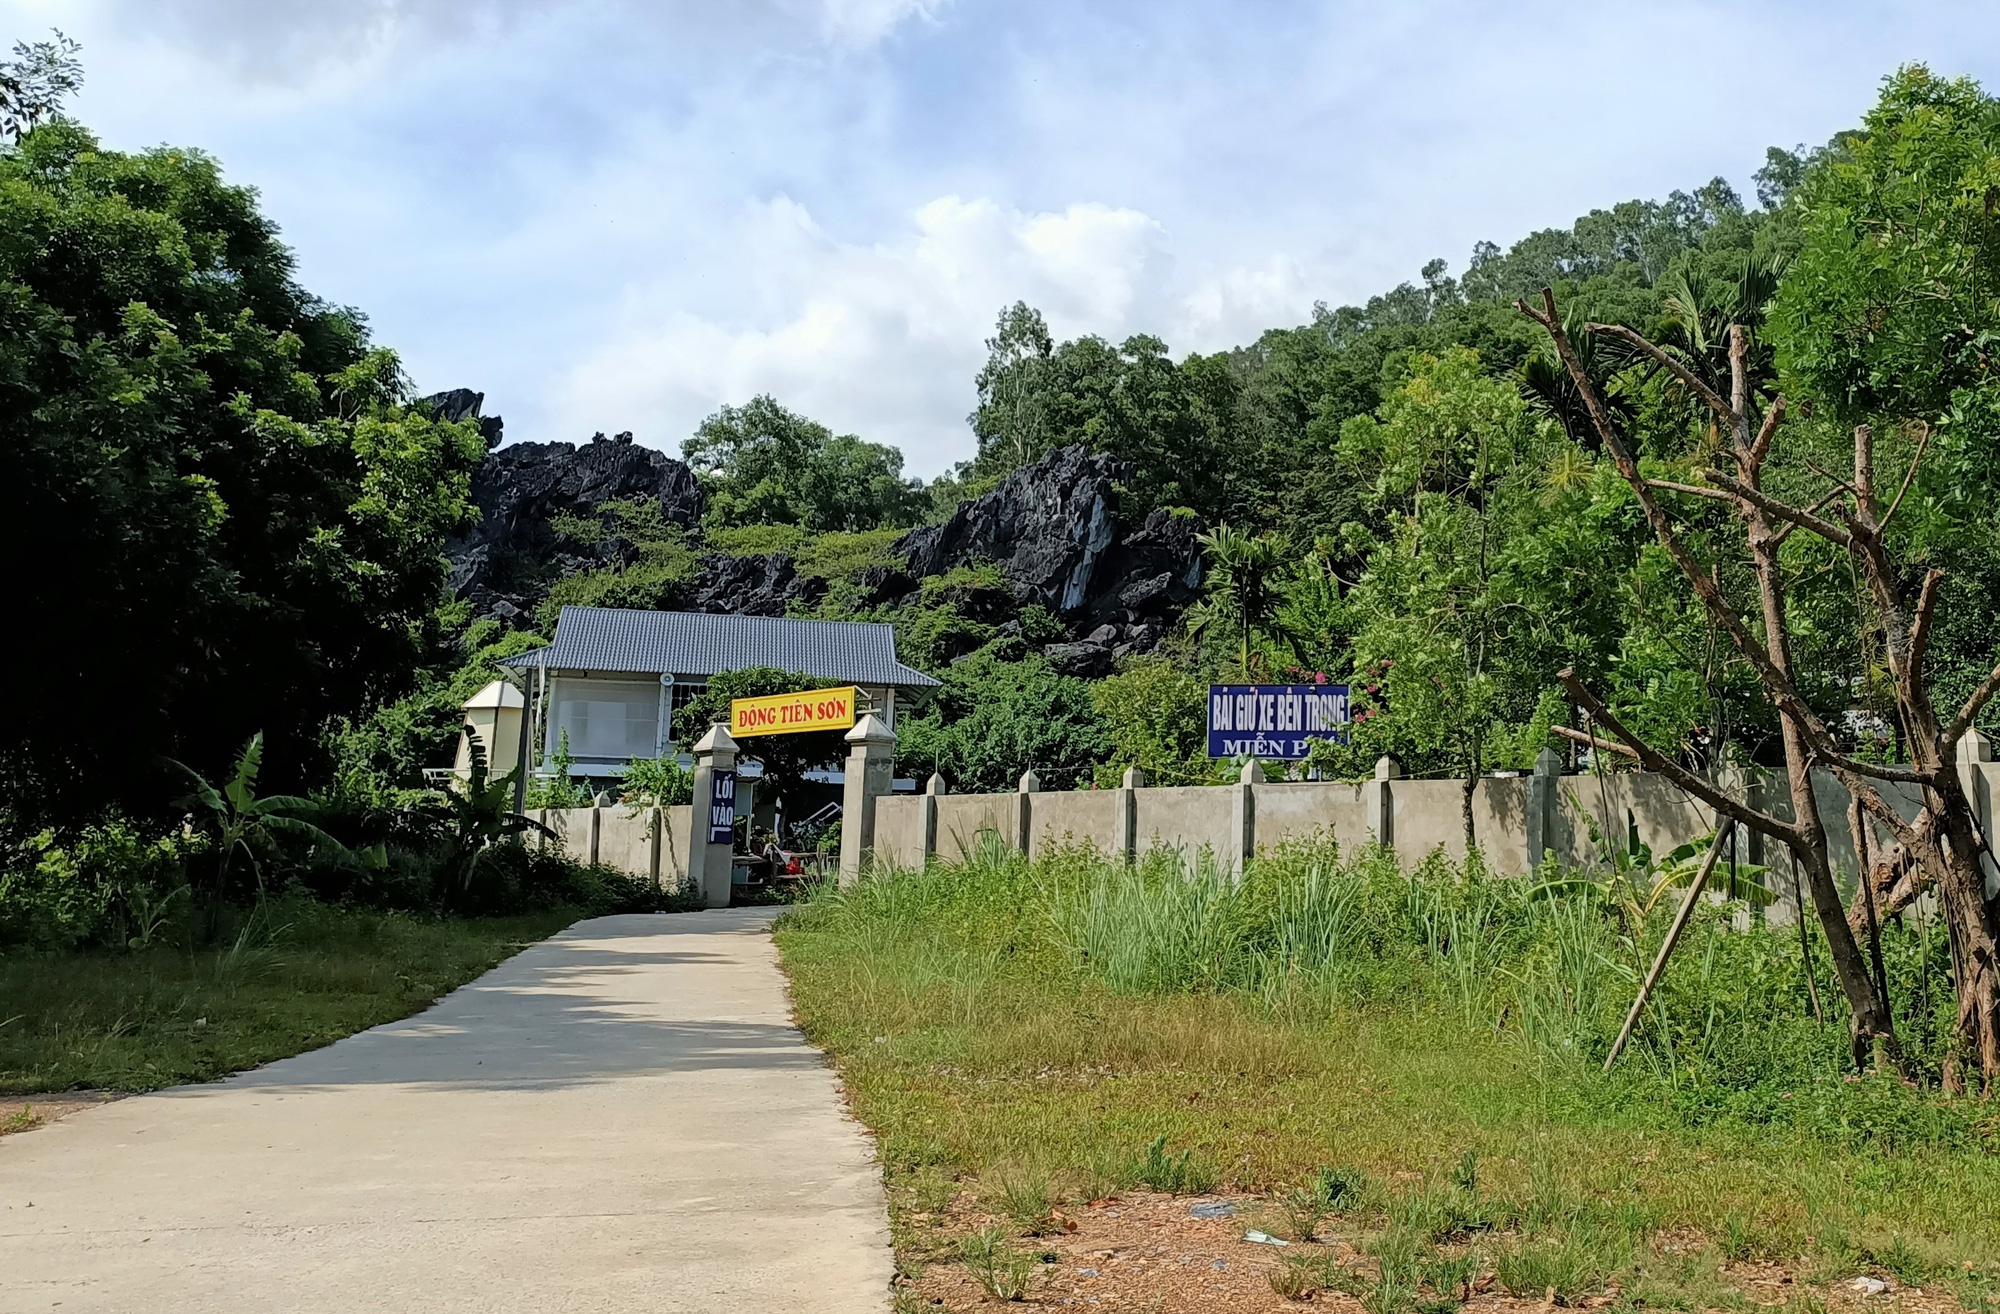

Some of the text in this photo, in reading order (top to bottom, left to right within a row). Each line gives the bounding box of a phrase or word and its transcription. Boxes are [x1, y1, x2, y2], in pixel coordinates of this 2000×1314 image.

[738, 697, 847, 731] ĐỘNG TIÊN SƠN
[1212, 686, 1345, 732] BÃI GIỮ XE BÊN TRONG
[1222, 732, 1286, 756] MIỄN
[715, 774, 734, 799] LỐI
[712, 802, 734, 826] VÀO
